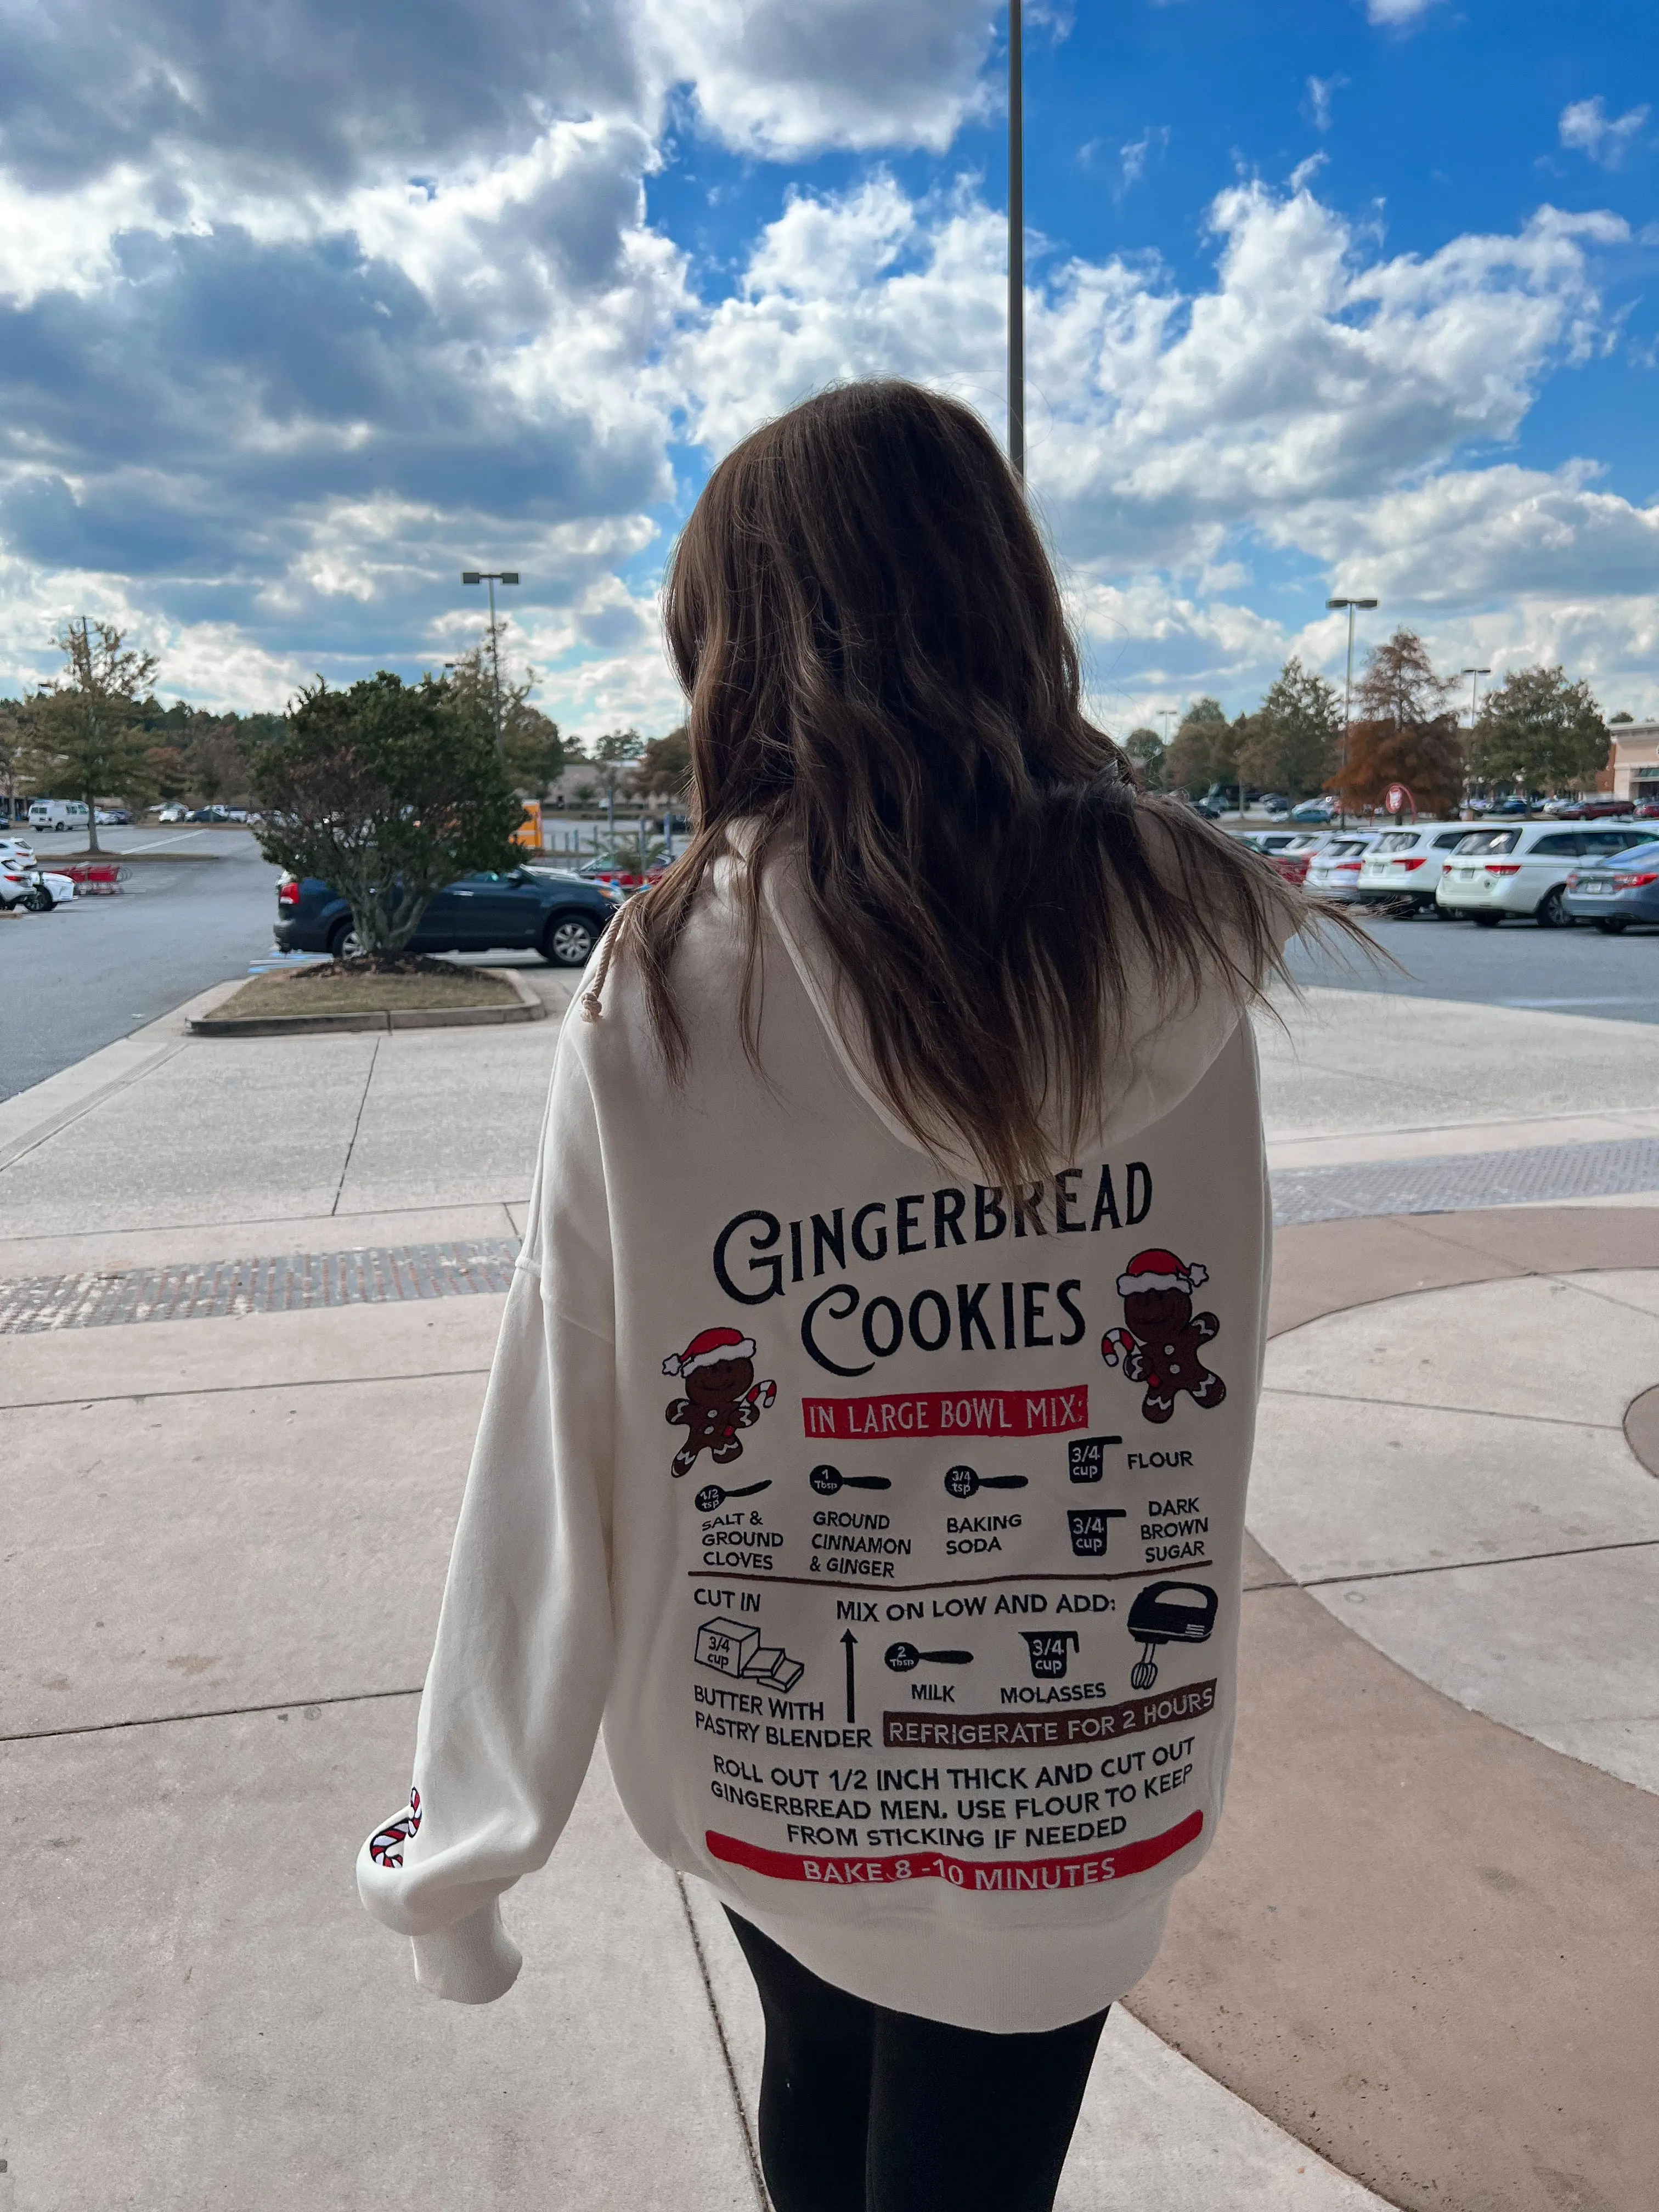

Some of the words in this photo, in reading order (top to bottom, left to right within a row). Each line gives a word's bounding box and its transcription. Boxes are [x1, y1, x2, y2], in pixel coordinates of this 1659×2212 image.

[713, 1161, 1152, 1305] GINGERBREAD
[802, 1279, 1086, 1378] COOKIES
[809, 1405, 836, 1434] IN
[849, 1401, 930, 1434] LARGE
[941, 1398, 1013, 1430] BOWL
[1071, 1446, 1101, 1463] 3/4
[1127, 1451, 1193, 1469] FLOUR
[822, 1469, 828, 1480] 1
[952, 1471, 970, 1481] 3/4
[1073, 1464, 1098, 1478] cup
[700, 1488, 719, 1500] 1/2
[814, 1480, 837, 1490] Tbsp
[952, 1482, 970, 1495] tsp
[1148, 1498, 1199, 1516] DARK
[702, 1513, 745, 1531] SALT
[749, 1511, 763, 1525] &
[813, 1511, 890, 1529] GROUND
[946, 1514, 1022, 1533] BAKING
[1073, 1517, 1104, 1534] 3/4
[1141, 1517, 1208, 1540] BROWN
[702, 1532, 783, 1547] GROUND
[811, 1534, 911, 1555] CINNAMON
[946, 1537, 1002, 1554] SODA
[1076, 1538, 1102, 1550] cup
[703, 1551, 773, 1570] CLOVES
[1145, 1541, 1205, 1562] SUGAR
[810, 1556, 821, 1572] &
[826, 1558, 895, 1578] GINGER
[694, 1588, 735, 1608] CUT
[741, 1592, 760, 1612] IN
[837, 1601, 879, 1622] MIX
[887, 1602, 924, 1621] ON
[933, 1597, 986, 1618] LOW
[994, 1595, 1048, 1615] AND
[1056, 1595, 1115, 1613] ADD:
[709, 1637, 730, 1652] 3/4
[898, 1646, 906, 1657] 2
[1032, 1638, 1065, 1656] 3/4
[708, 1654, 729, 1669] cup
[1035, 1658, 1062, 1674] cup
[912, 1684, 955, 1702] MILK
[1001, 1684, 1106, 1704] MOLASSES
[694, 1685, 763, 1716] BUTTER
[768, 1697, 823, 1721] WITH
[889, 1722, 1058, 1745] REFRIGERATE
[1068, 1717, 1114, 1739] FOR
[1123, 1712, 1136, 1729] 2
[1144, 1688, 1212, 1725] HOURS
[696, 1711, 760, 1743] PASTRY
[766, 1726, 873, 1748] BLENDER
[713, 1754, 763, 1783] ROLL
[771, 1768, 820, 1789] OUT
[829, 1769, 868, 1791] 1/2
[877, 1768, 939, 1791] INCH
[946, 1768, 1028, 1790] THICK
[1035, 1763, 1092, 1788] AND
[1101, 1751, 1146, 1778] CUT
[1153, 1737, 1195, 1767] OUT
[711, 1780, 871, 1819] GINGERBREAD
[881, 1800, 947, 1820] MEN.
[958, 1799, 1006, 1820] USE
[1015, 1792, 1099, 1819] FLOUR
[1105, 1785, 1136, 1807] TO
[1144, 1763, 1193, 1799] KEEP
[787, 1824, 858, 1846] FROM
[867, 1827, 984, 1847] STICKING
[995, 1829, 1017, 1848] IF
[1026, 1816, 1126, 1847] NEEDED
[803, 1860, 883, 1883] BAKE
[975, 1858, 1115, 1890] MINUTES
